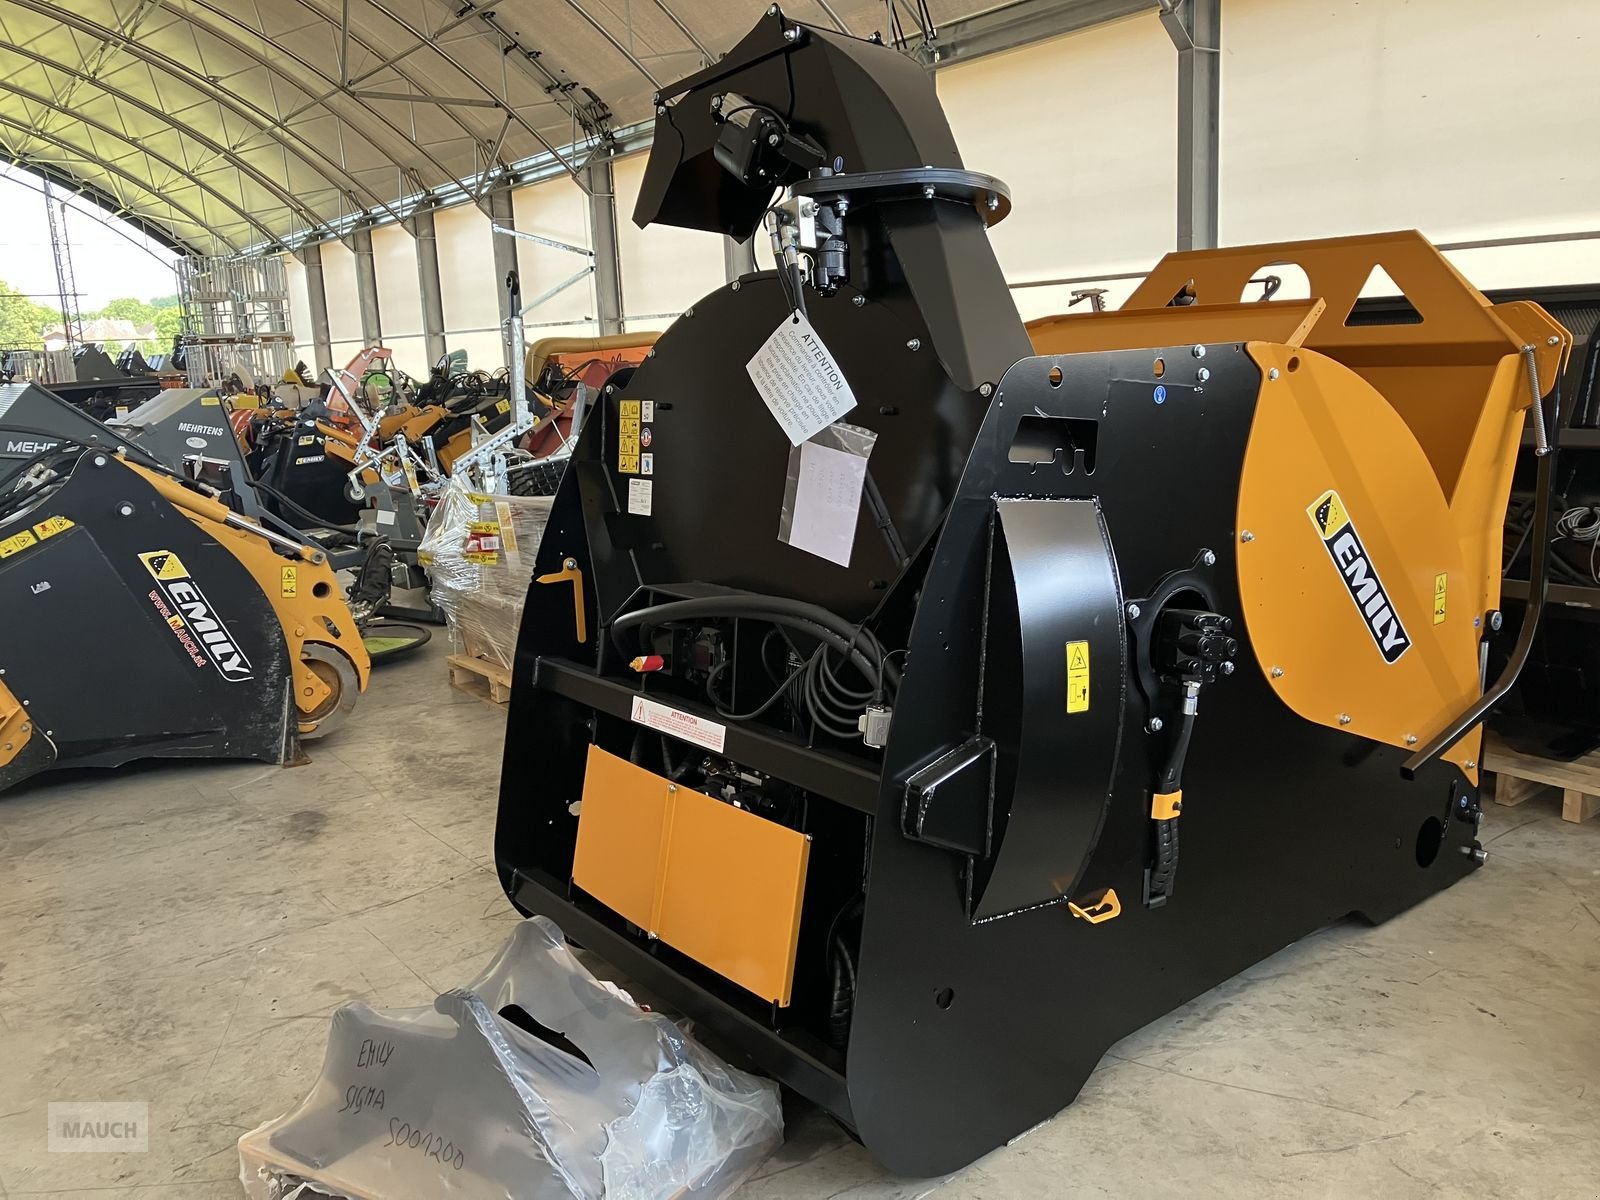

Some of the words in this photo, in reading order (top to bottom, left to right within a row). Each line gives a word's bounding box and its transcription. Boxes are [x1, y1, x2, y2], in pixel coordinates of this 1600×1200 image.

[778, 331, 796, 356] présence
[815, 385, 827, 400] sous
[826, 400, 837, 416] votre
[789, 330, 812, 363] Commande
[815, 369, 834, 395] contrôler
[802, 334, 842, 390] ATTENTION
[804, 384, 813, 395] cas
[779, 363, 803, 395] réclamation
[806, 404, 822, 424] pourra
[787, 390, 803, 410] charge
[178, 422, 224, 436] MEHRTENS
[1333, 532, 1406, 652] EMILY
[148, 589, 207, 667] www.MAUCH.at
[168, 582, 250, 672] EMILY
[671, 711, 697, 725] ATTENTION
[357, 1039, 395, 1068] EMILY
[338, 1085, 385, 1114] SIGMA
